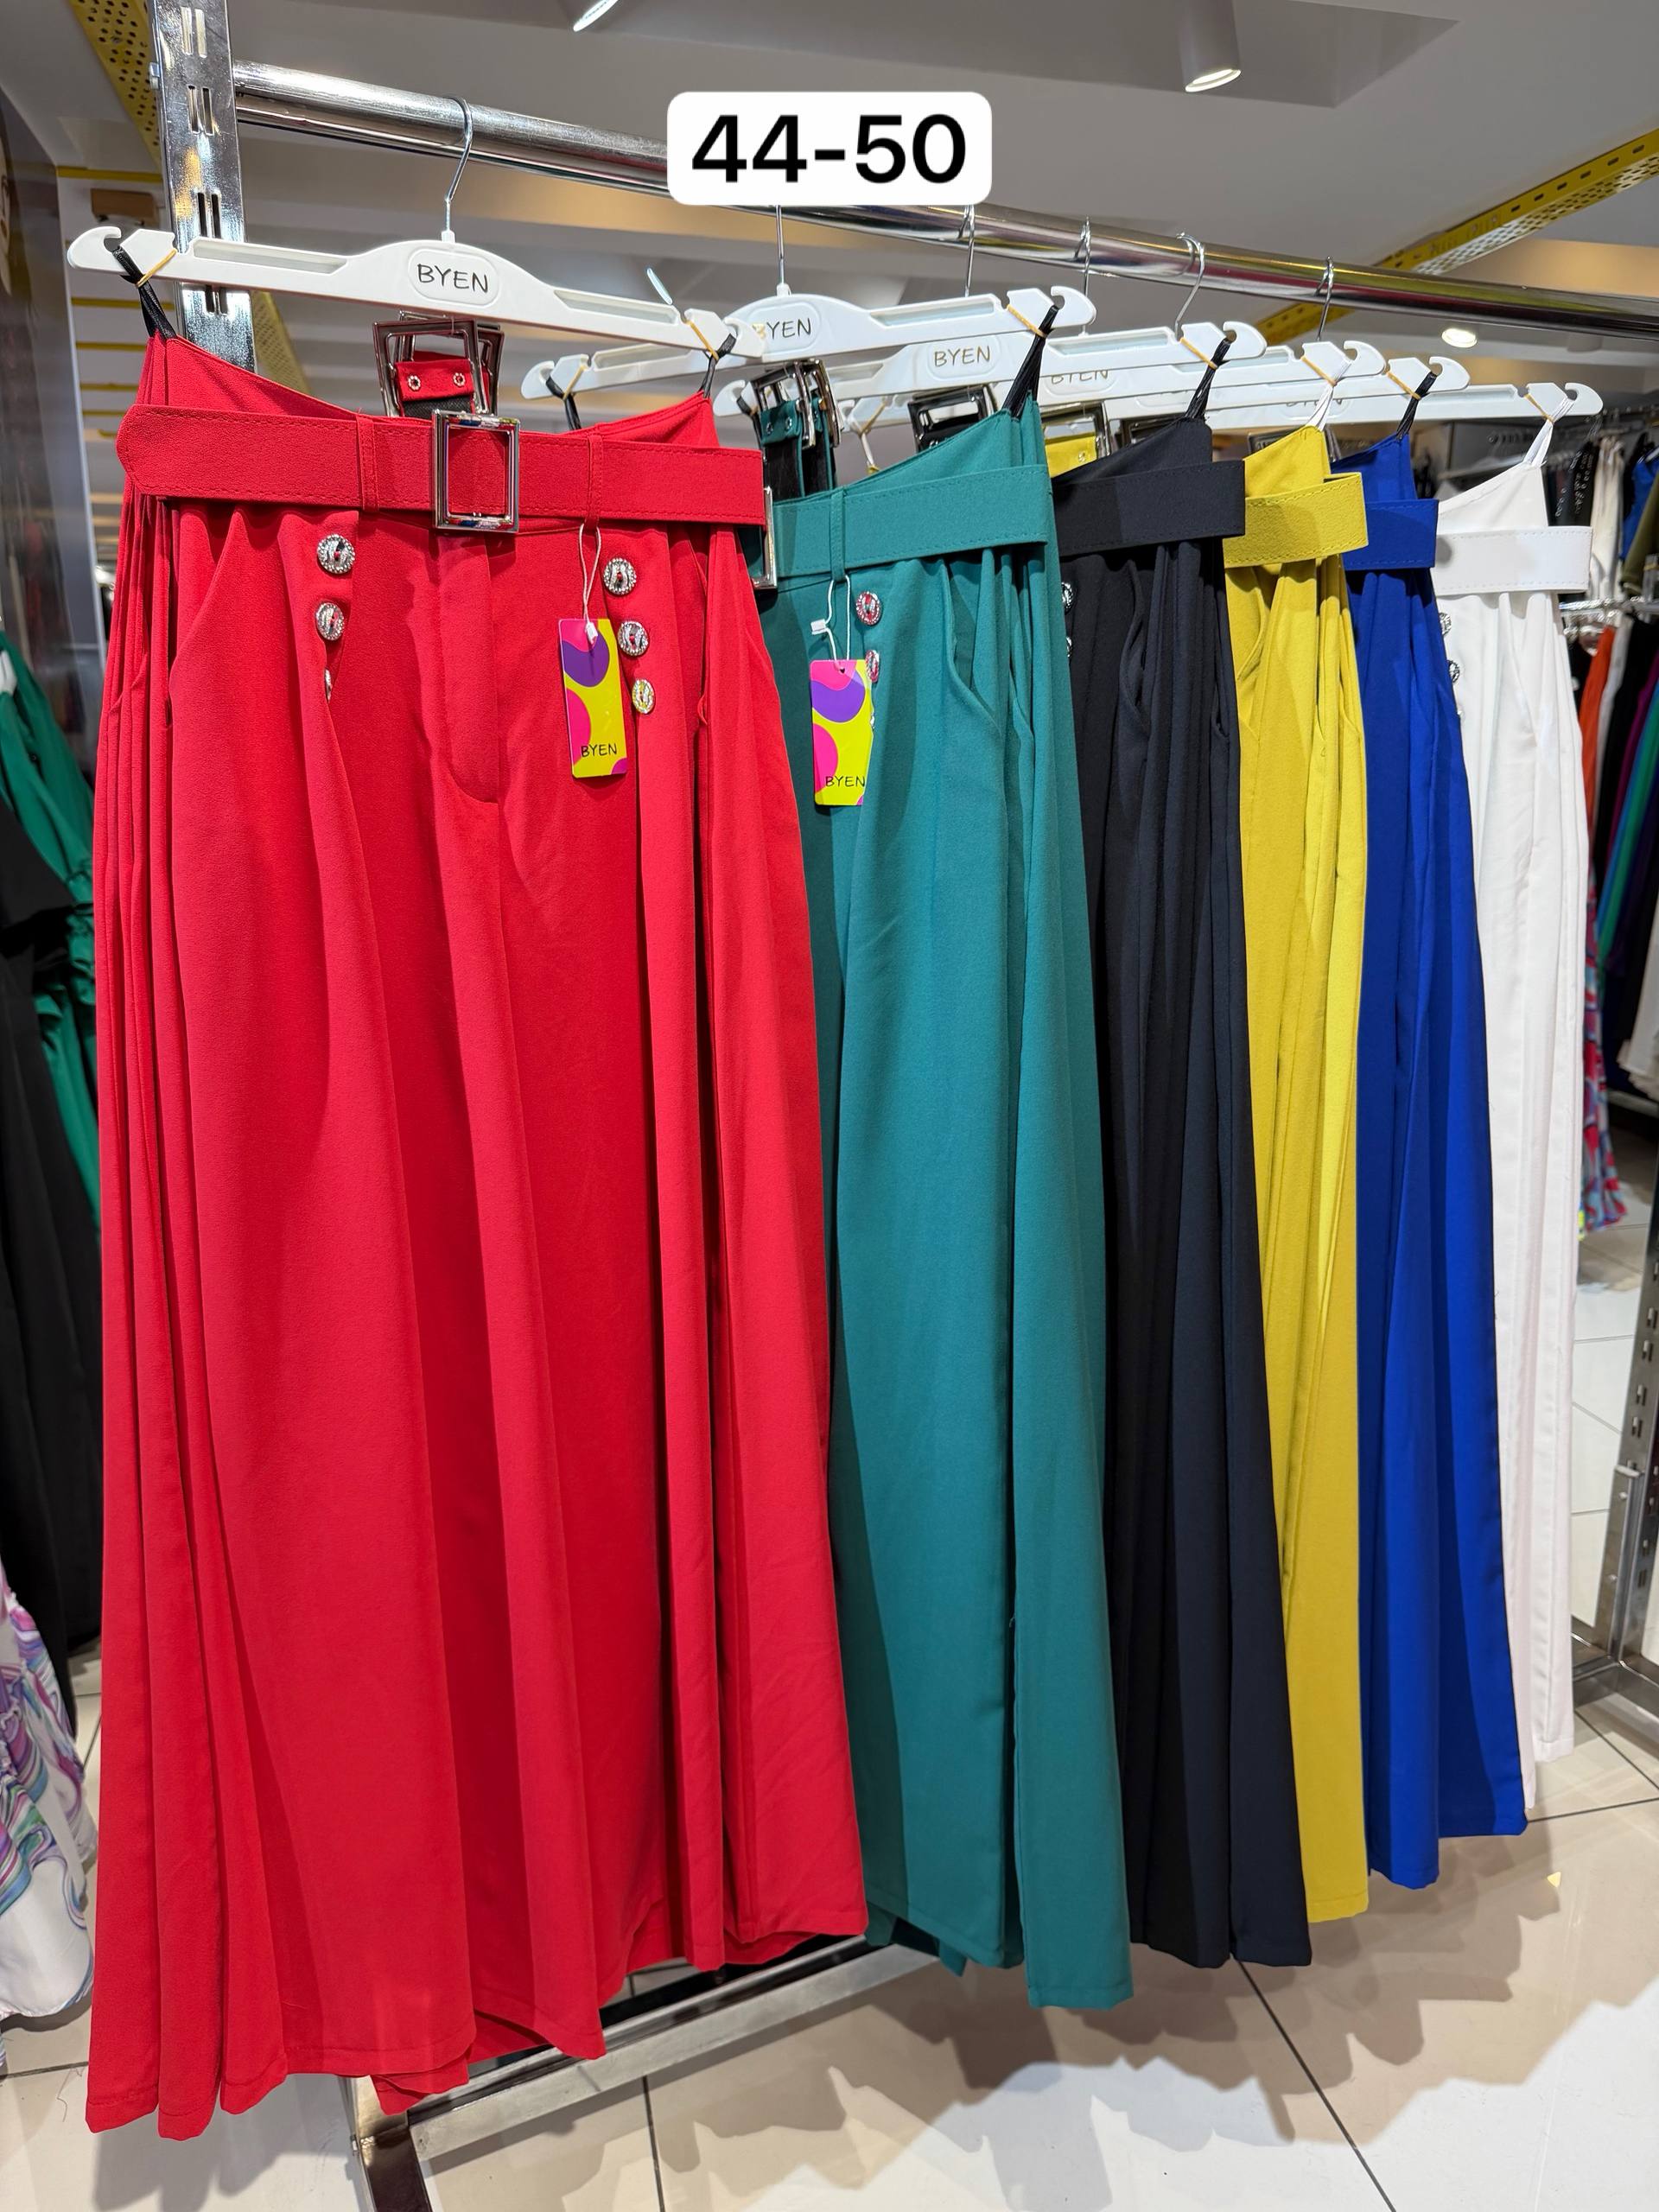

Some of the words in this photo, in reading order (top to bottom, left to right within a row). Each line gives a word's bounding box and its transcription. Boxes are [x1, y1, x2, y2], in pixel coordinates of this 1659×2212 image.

[416, 263, 489, 294] BYEN
[934, 345, 991, 367] BYEN
[581, 742, 618, 758] BYEN
[824, 775, 866, 788] BYEN
